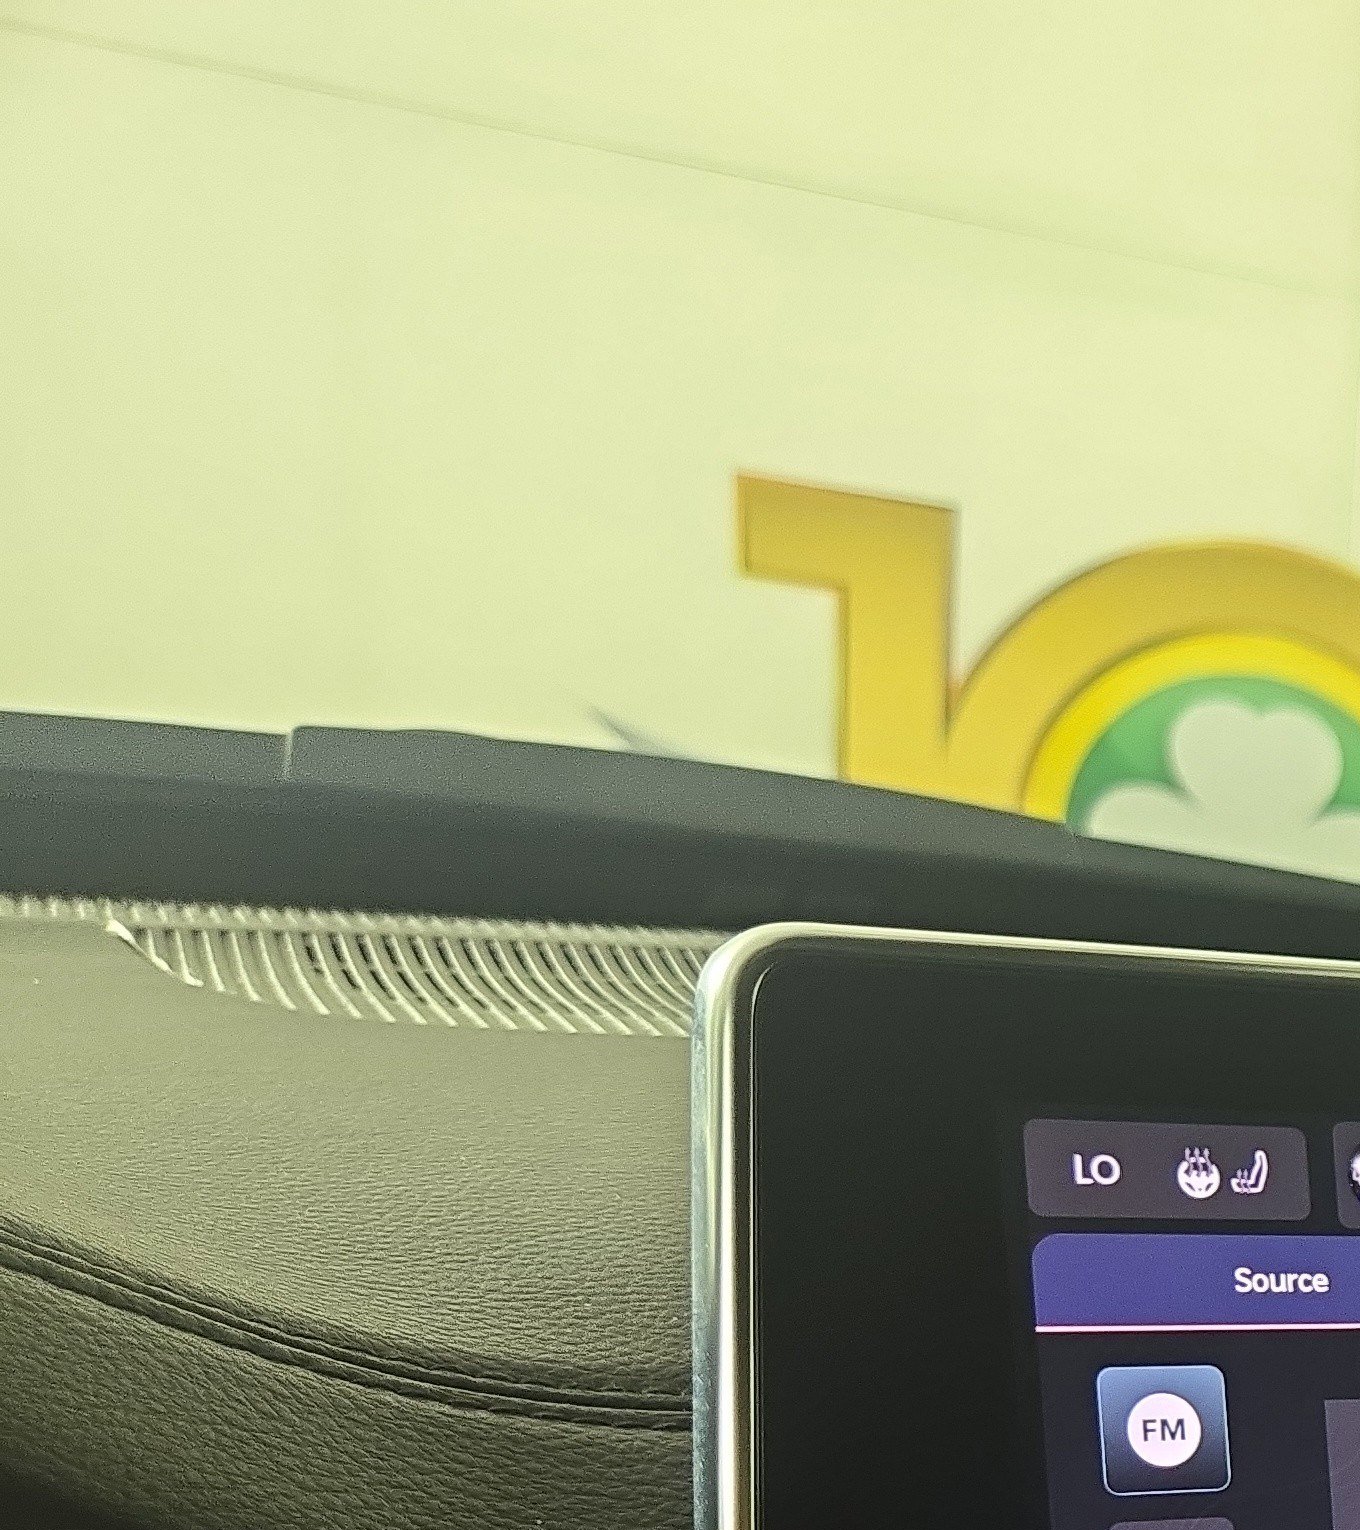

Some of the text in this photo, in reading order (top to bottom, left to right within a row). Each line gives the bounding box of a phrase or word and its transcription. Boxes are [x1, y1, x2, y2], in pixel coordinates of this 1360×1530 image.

[1073, 1153, 1121, 1185] LO
[1234, 1267, 1330, 1293] Source
[1142, 1418, 1186, 1442] FM
